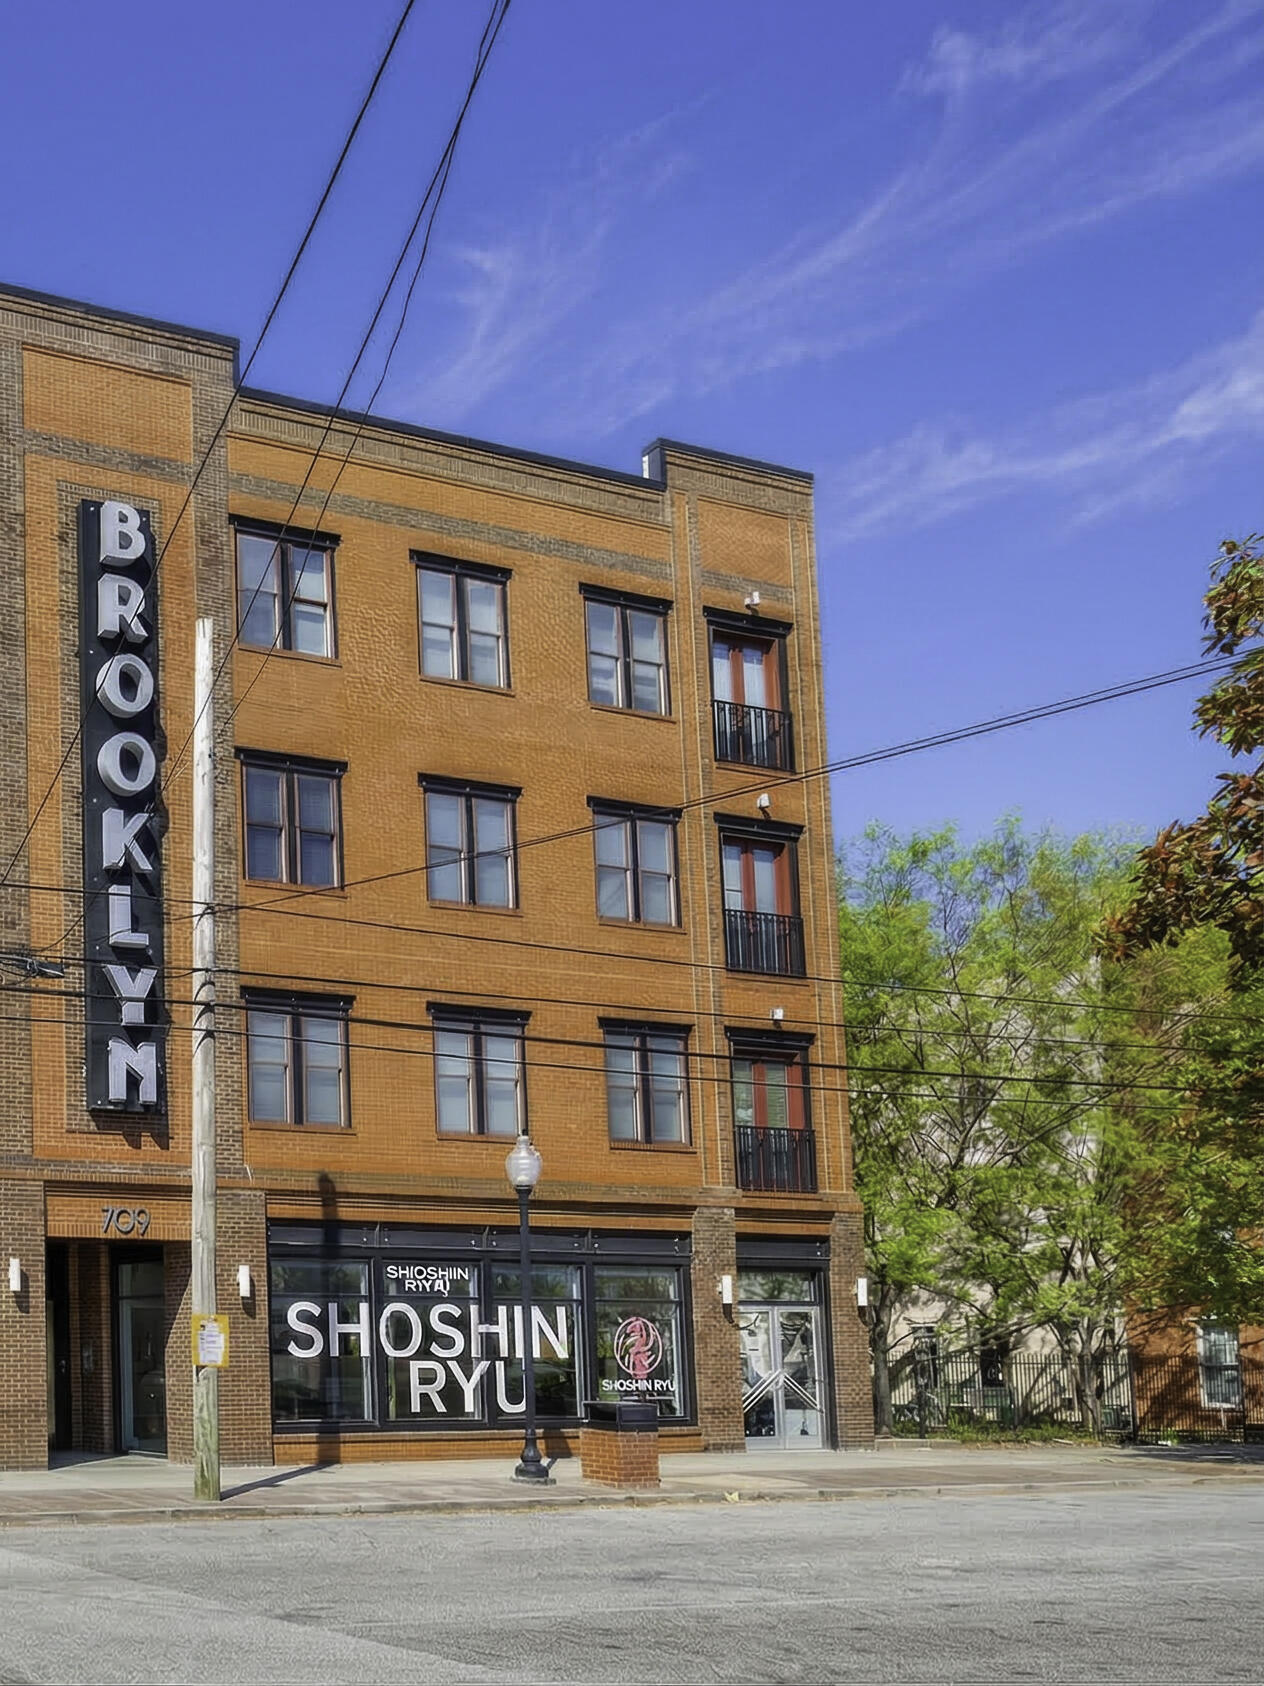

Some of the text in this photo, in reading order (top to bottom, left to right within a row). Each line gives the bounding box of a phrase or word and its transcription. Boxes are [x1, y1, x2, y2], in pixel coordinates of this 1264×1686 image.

[102, 1207, 151, 1236] 709
[287, 1301, 569, 1359] SHOSHIN
[409, 1360, 527, 1414] RYU
[602, 1379, 675, 1392] SHOSHIN RYU
